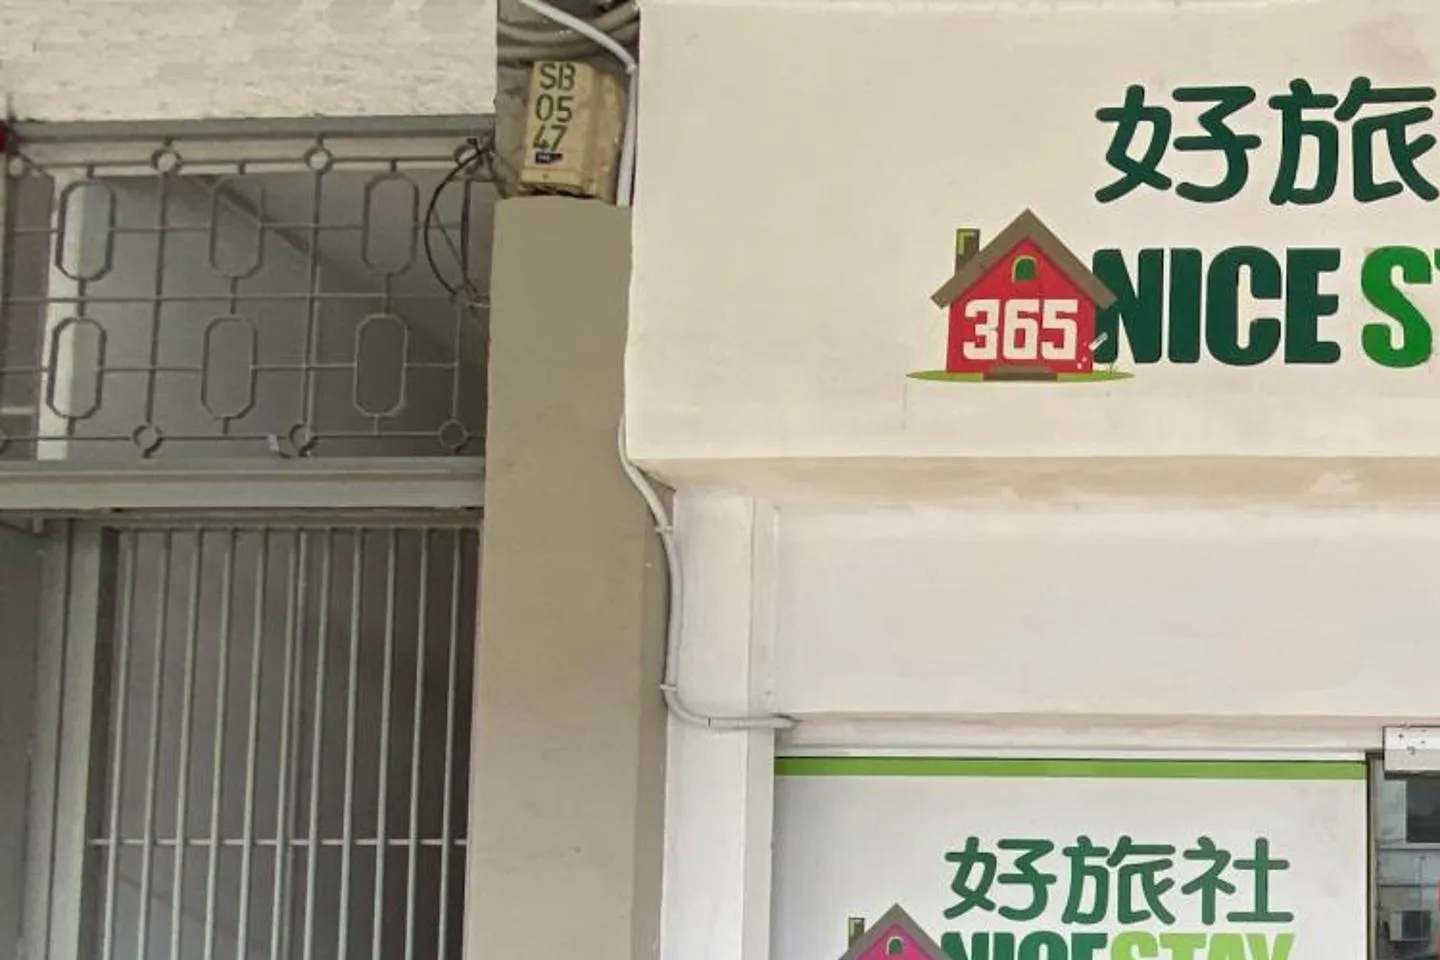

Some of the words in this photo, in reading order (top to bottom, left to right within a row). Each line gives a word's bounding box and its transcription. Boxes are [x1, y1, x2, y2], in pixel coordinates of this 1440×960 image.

[538, 62, 576, 90] SB
[534, 94, 573, 123] 05
[962, 298, 1079, 360] 365
[1092, 246, 1341, 365] NICE
[943, 835, 1294, 926] 好旅社
